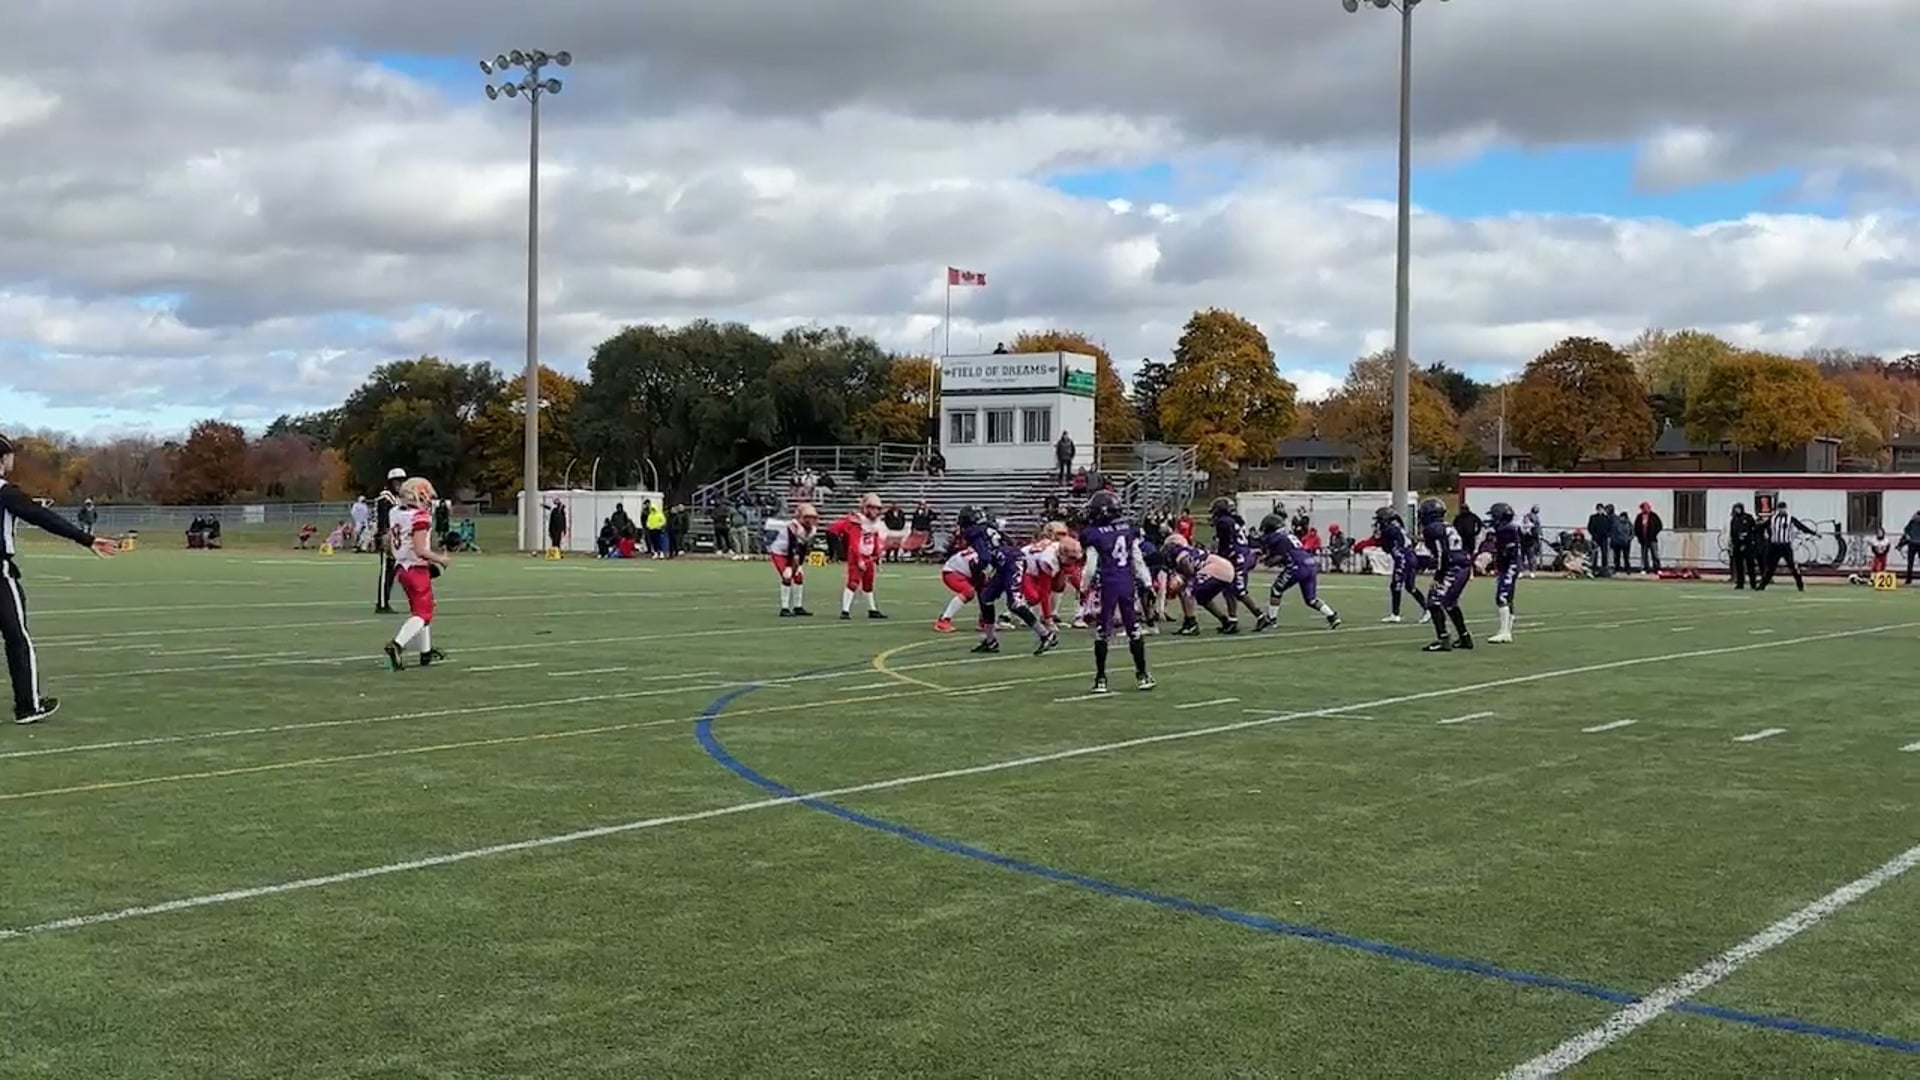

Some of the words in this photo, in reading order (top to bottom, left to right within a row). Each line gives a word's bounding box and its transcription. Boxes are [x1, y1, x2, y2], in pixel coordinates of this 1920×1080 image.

[951, 366, 983, 378] FIELD
[985, 366, 998, 377] OF
[1002, 364, 1047, 376] DREAMS
[1111, 535, 1129, 566] 4
[1878, 574, 1893, 587] 20
